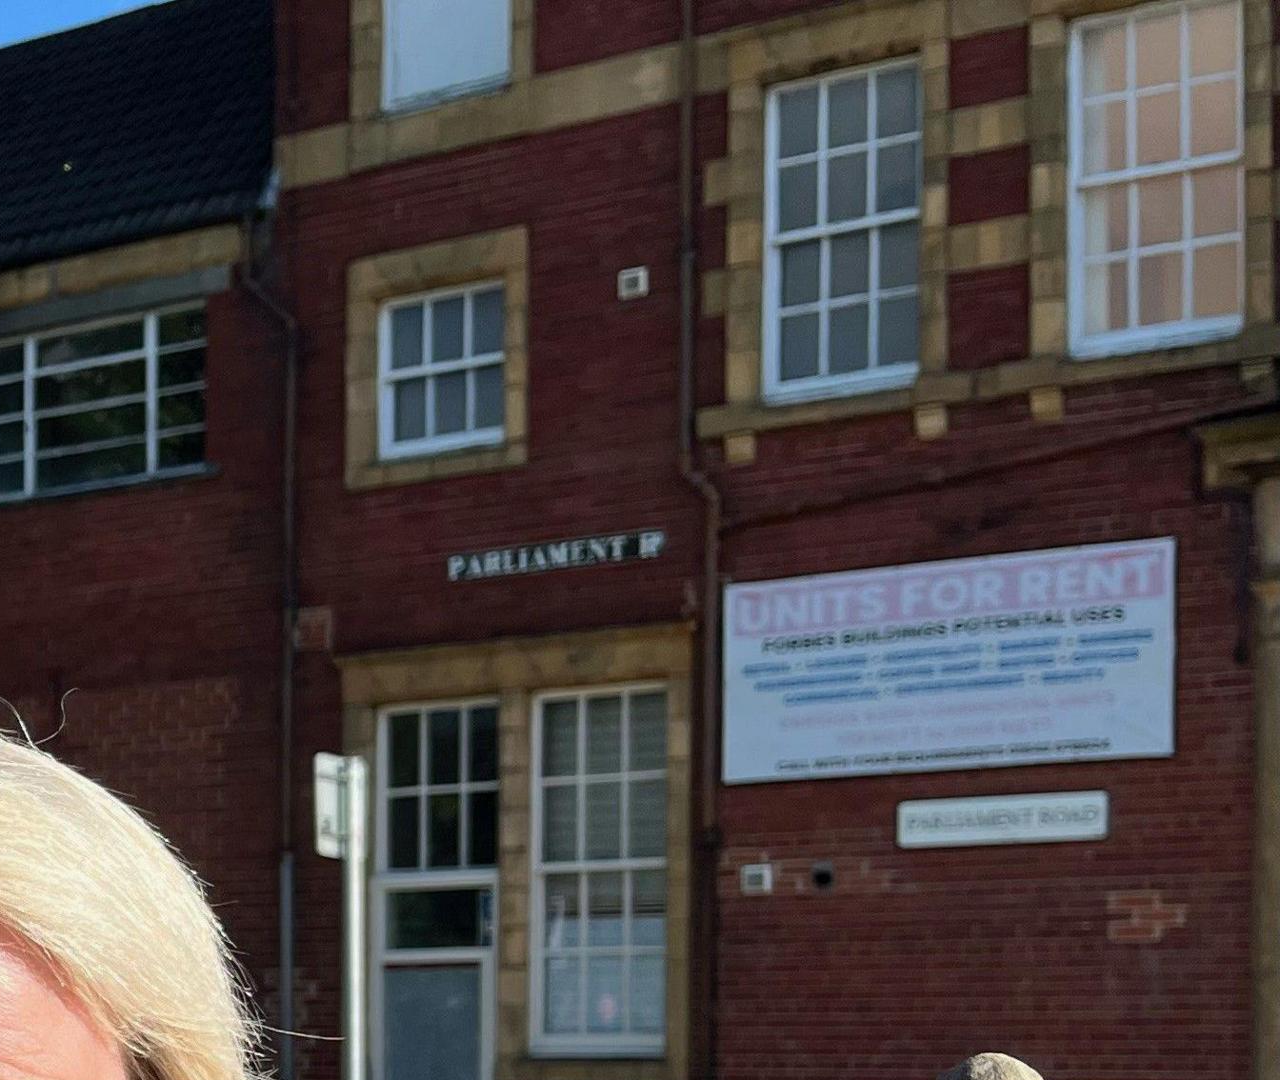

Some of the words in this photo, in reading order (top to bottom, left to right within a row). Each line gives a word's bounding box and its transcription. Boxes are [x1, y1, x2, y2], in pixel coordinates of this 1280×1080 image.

[448, 533, 628, 582] PARLIAMENT
[739, 583, 889, 632] UNITS
[901, 569, 1004, 618] FOR
[1021, 553, 1156, 605] RENT
[952, 610, 1066, 638] POTENTIAL
[1073, 604, 1126, 625] USES
[1038, 804, 1099, 825] ROAD
